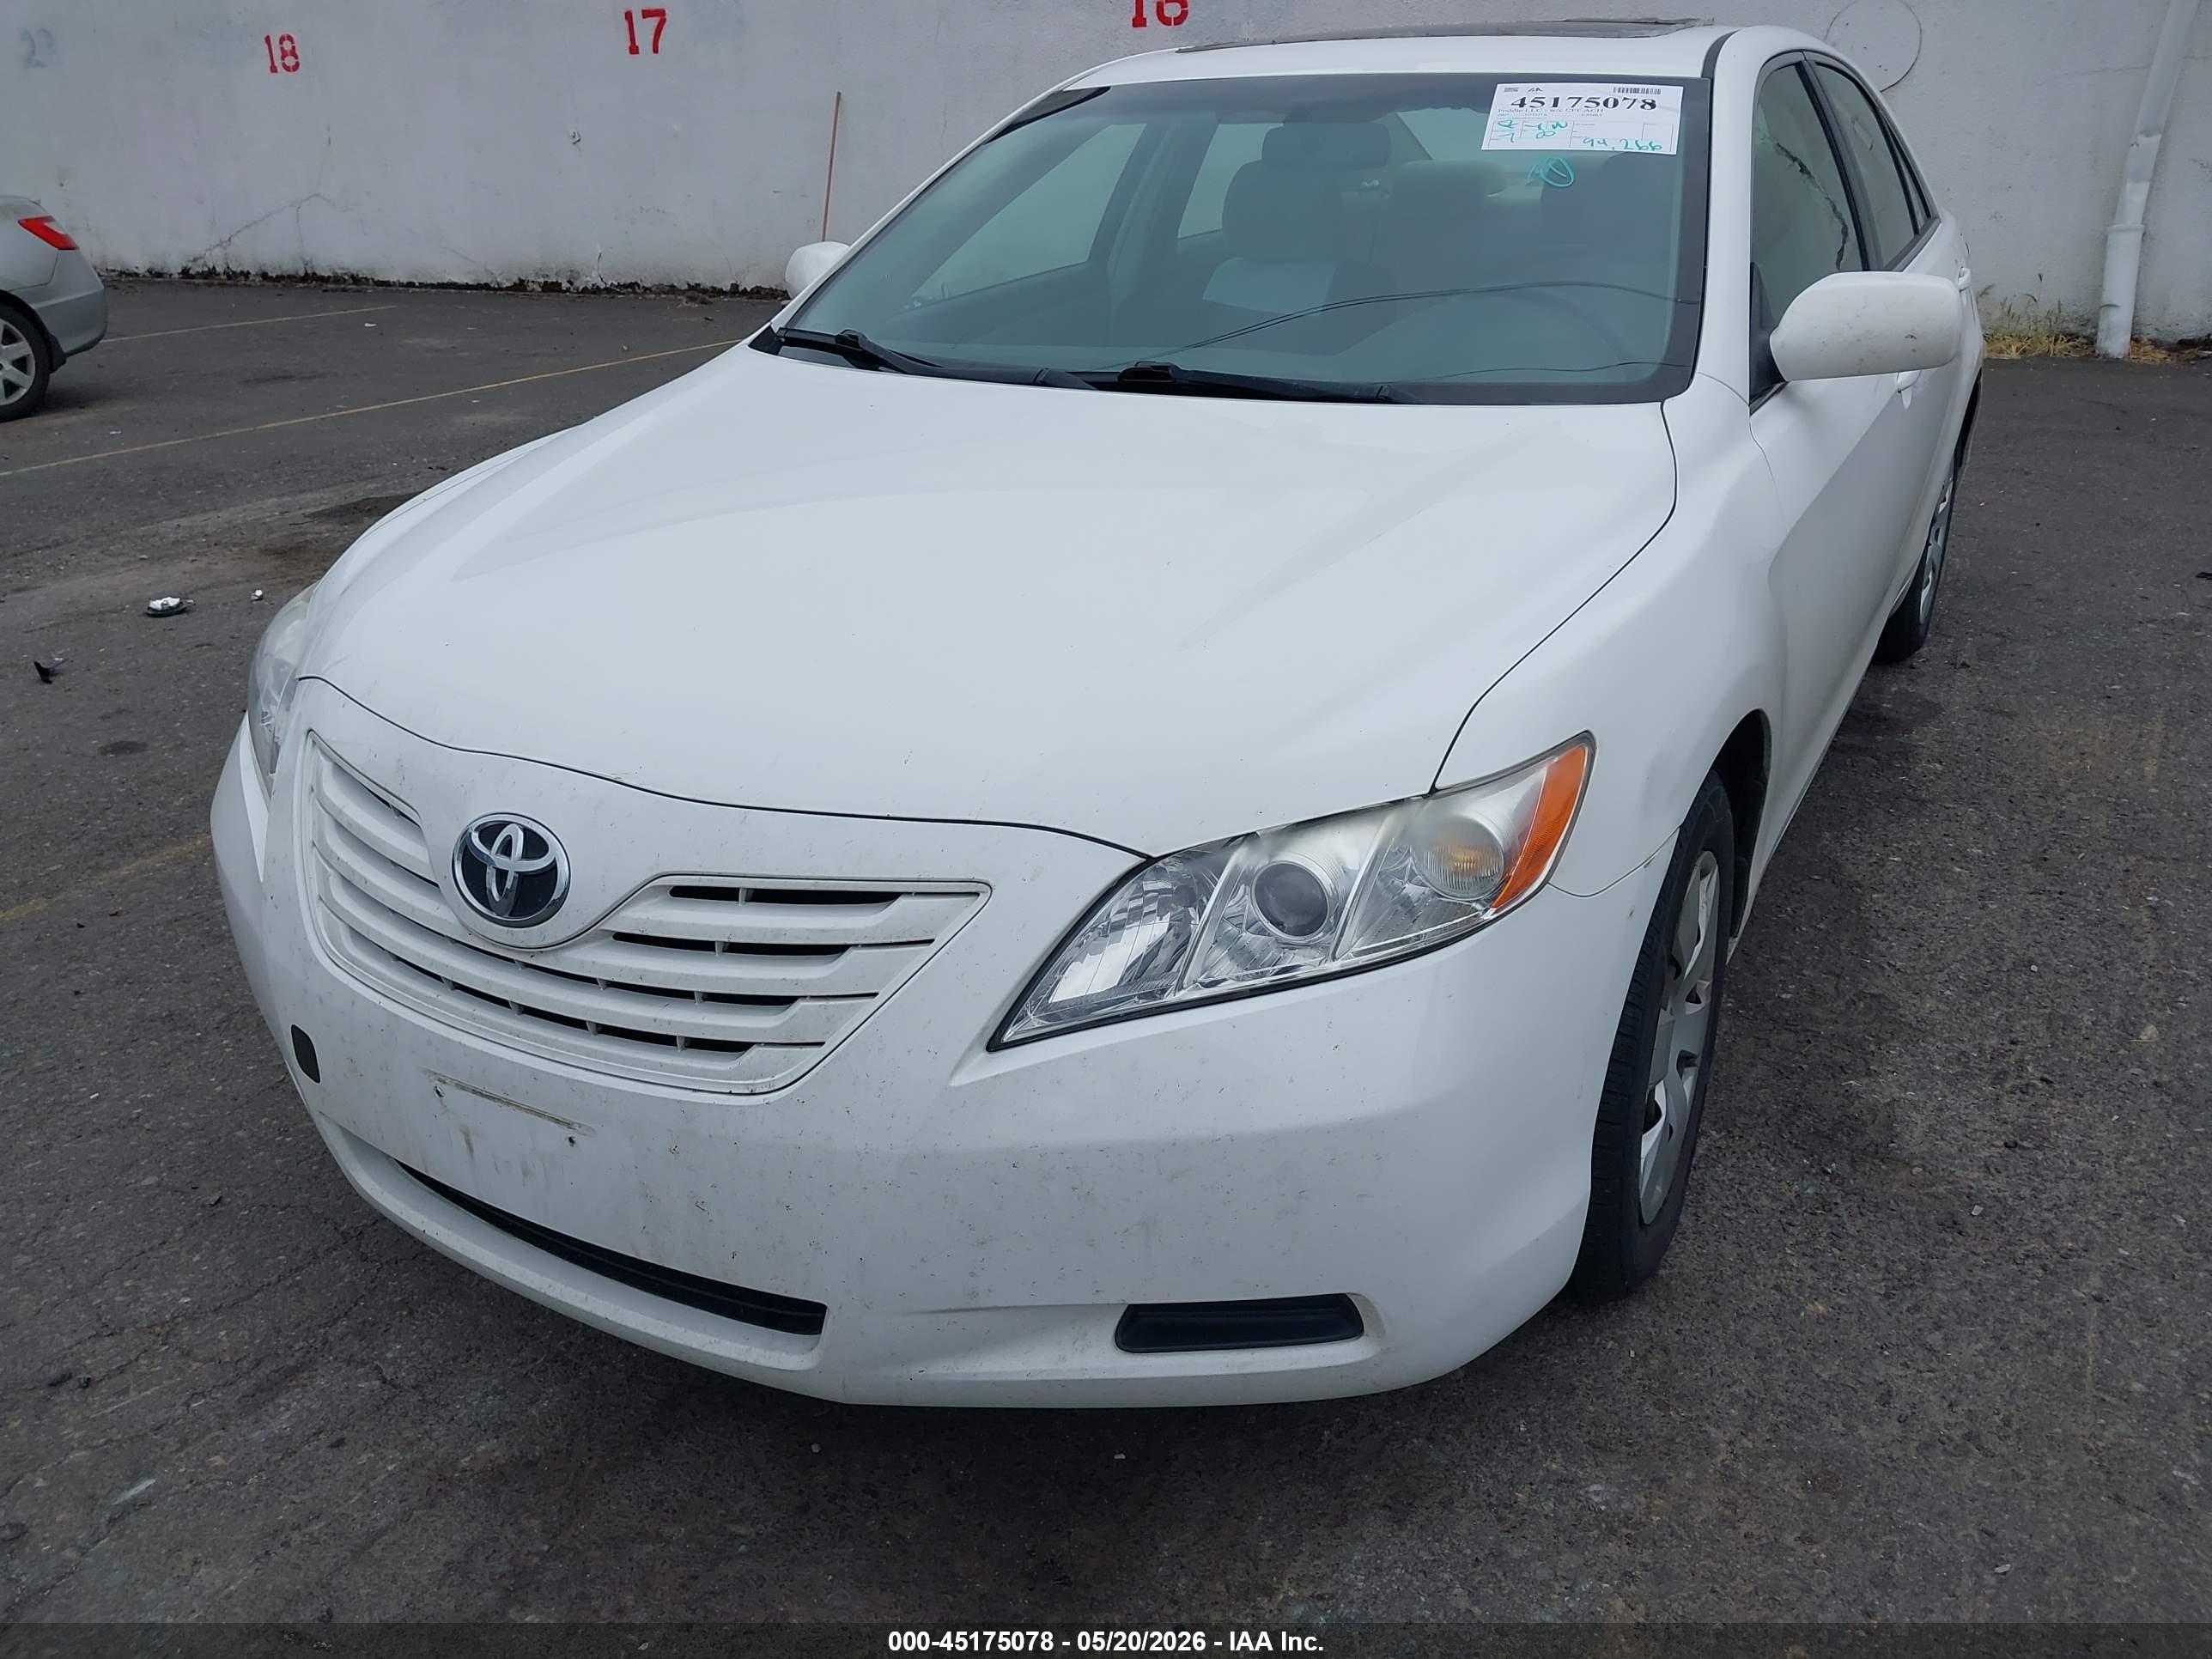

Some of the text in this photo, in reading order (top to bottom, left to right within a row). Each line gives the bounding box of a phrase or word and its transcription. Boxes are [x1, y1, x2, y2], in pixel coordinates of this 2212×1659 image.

[1131, 0, 1189, 28] 16
[624, 8, 667, 55] 17
[264, 34, 300, 74] 18
[1510, 95, 1657, 111] 45175078
